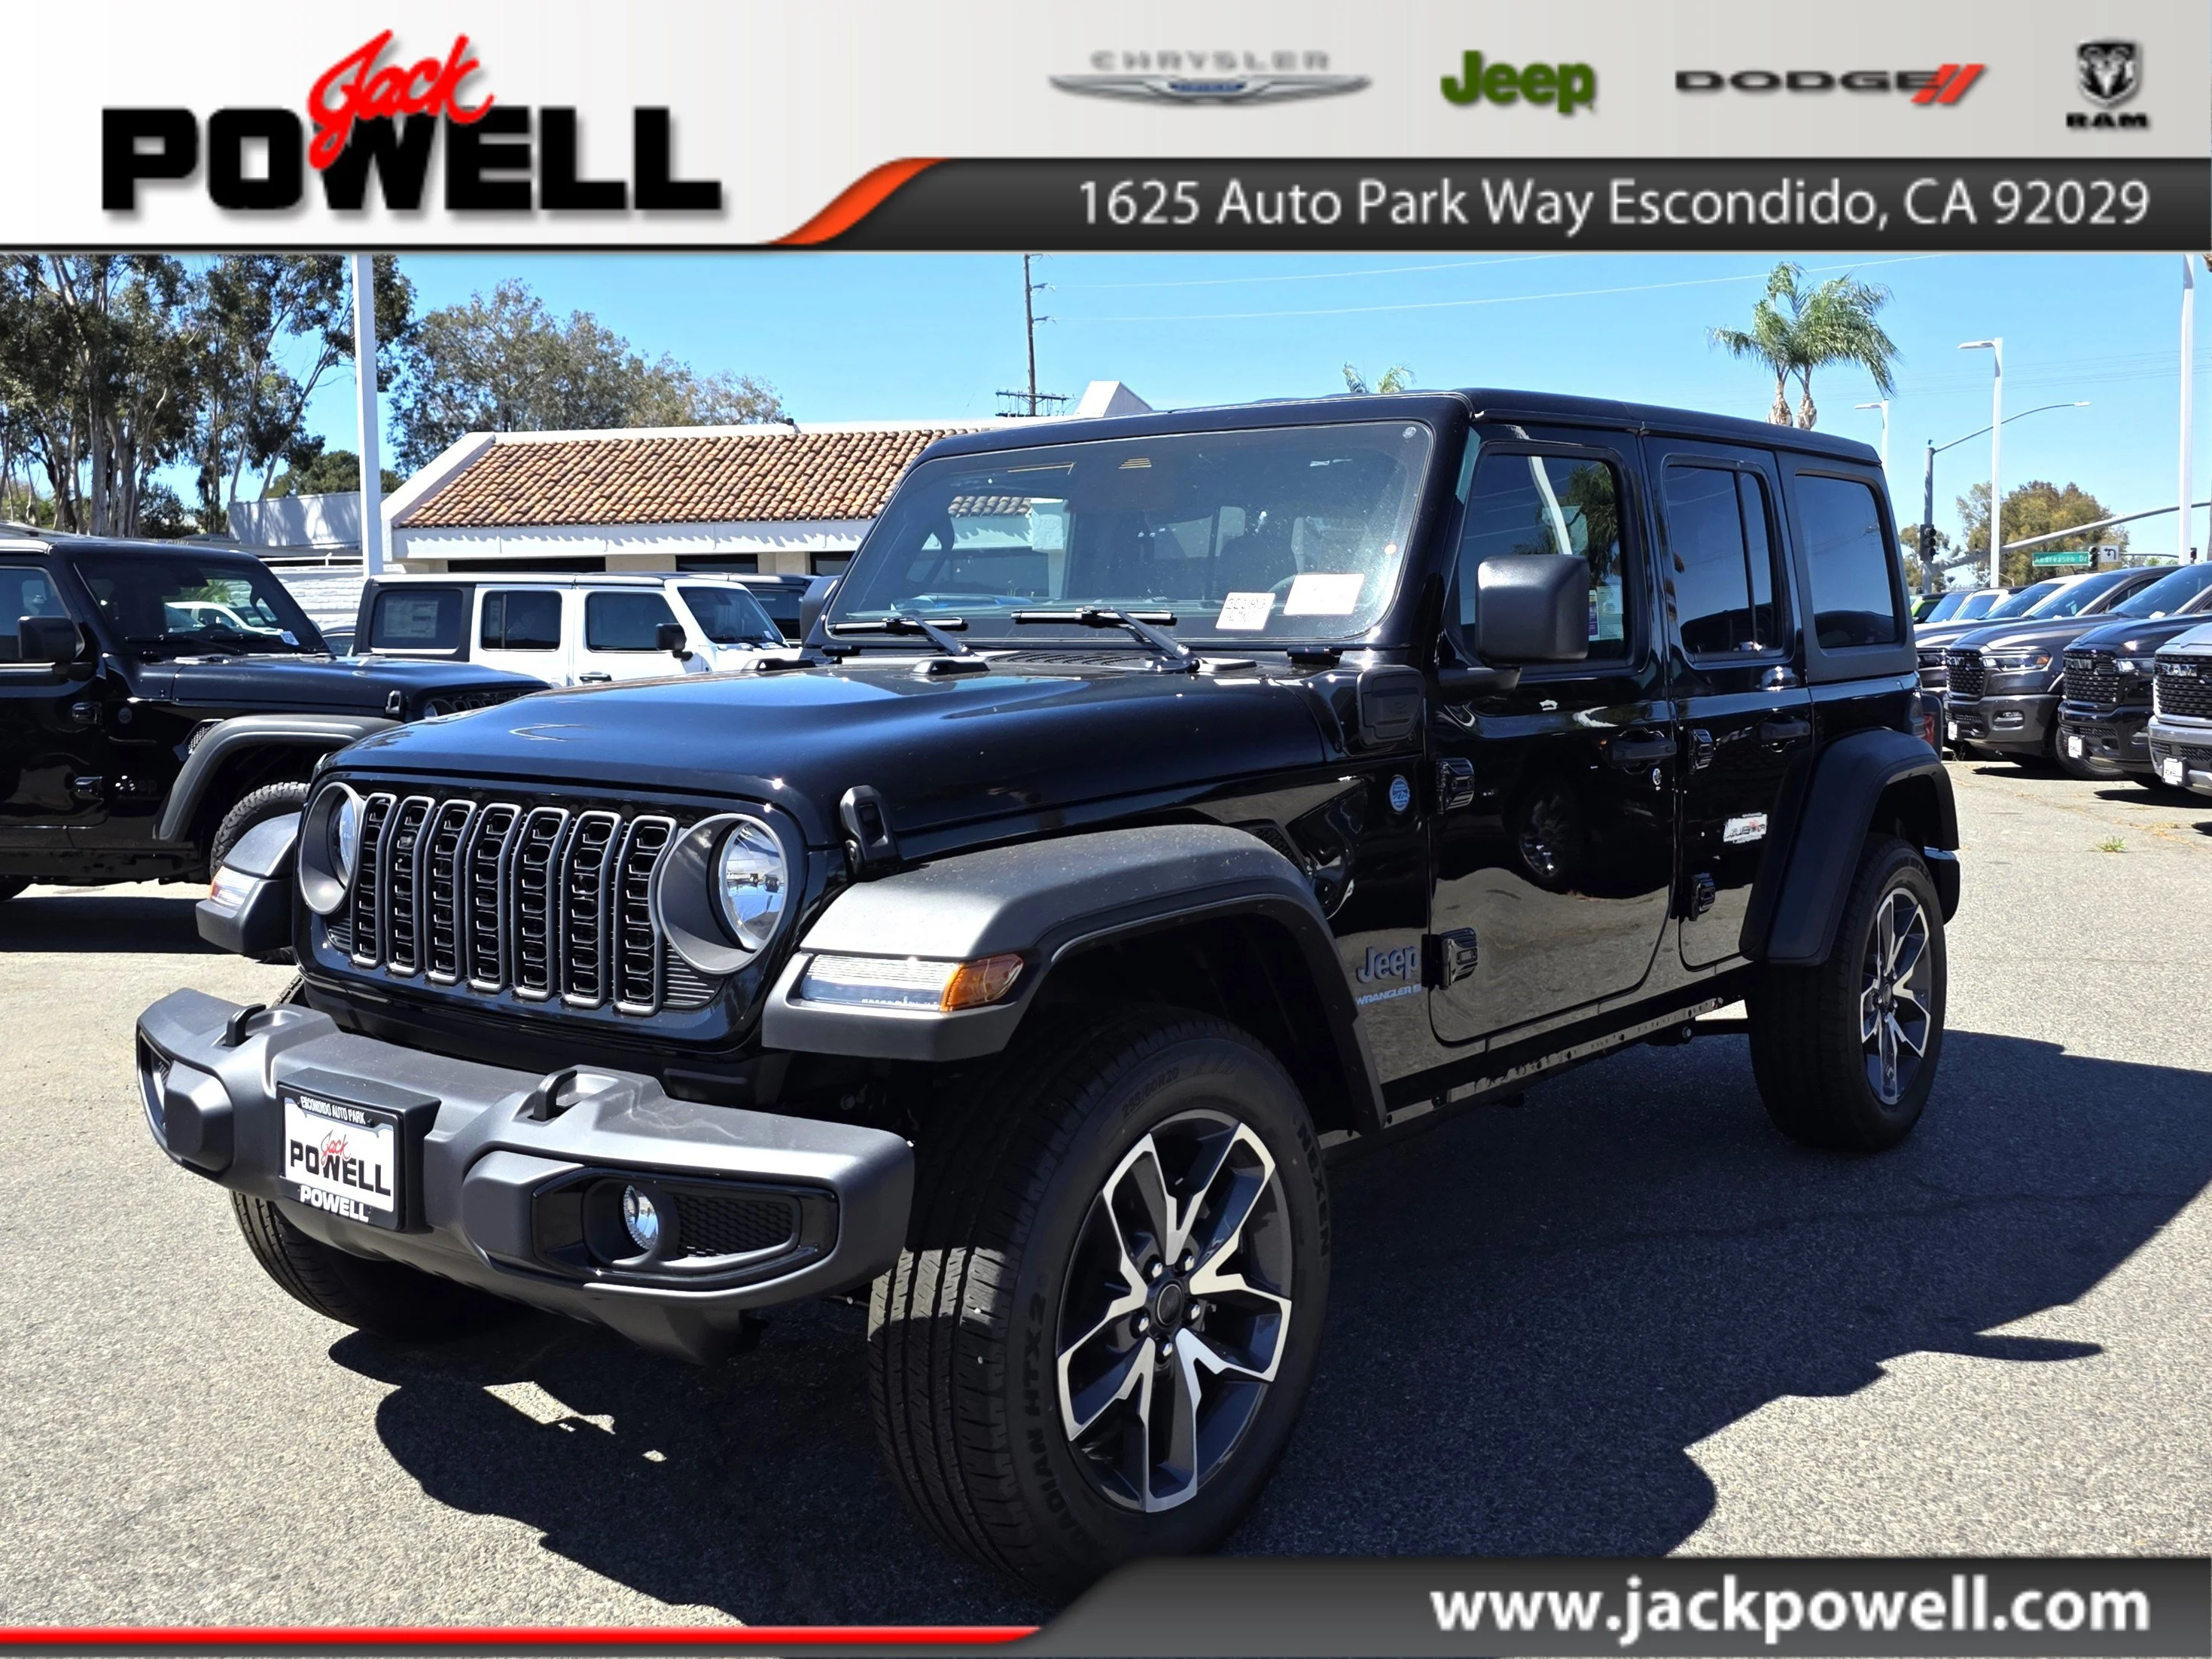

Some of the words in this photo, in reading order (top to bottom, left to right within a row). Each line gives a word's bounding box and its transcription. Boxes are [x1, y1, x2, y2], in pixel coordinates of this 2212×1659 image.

[2079, 554, 2088, 563] Dr
[1356, 945, 1419, 984] Jeep
[1356, 985, 1412, 1005] WRANGLER
[300, 1096, 331, 1117] ESCONDIDO
[332, 1105, 348, 1121] AUTO
[348, 1109, 366, 1125] PARK
[320, 1129, 352, 1166] Jack
[291, 1139, 391, 1197] POWELL
[300, 1185, 370, 1222] POWELL
[1296, 1121, 1330, 1257] NEXEN
